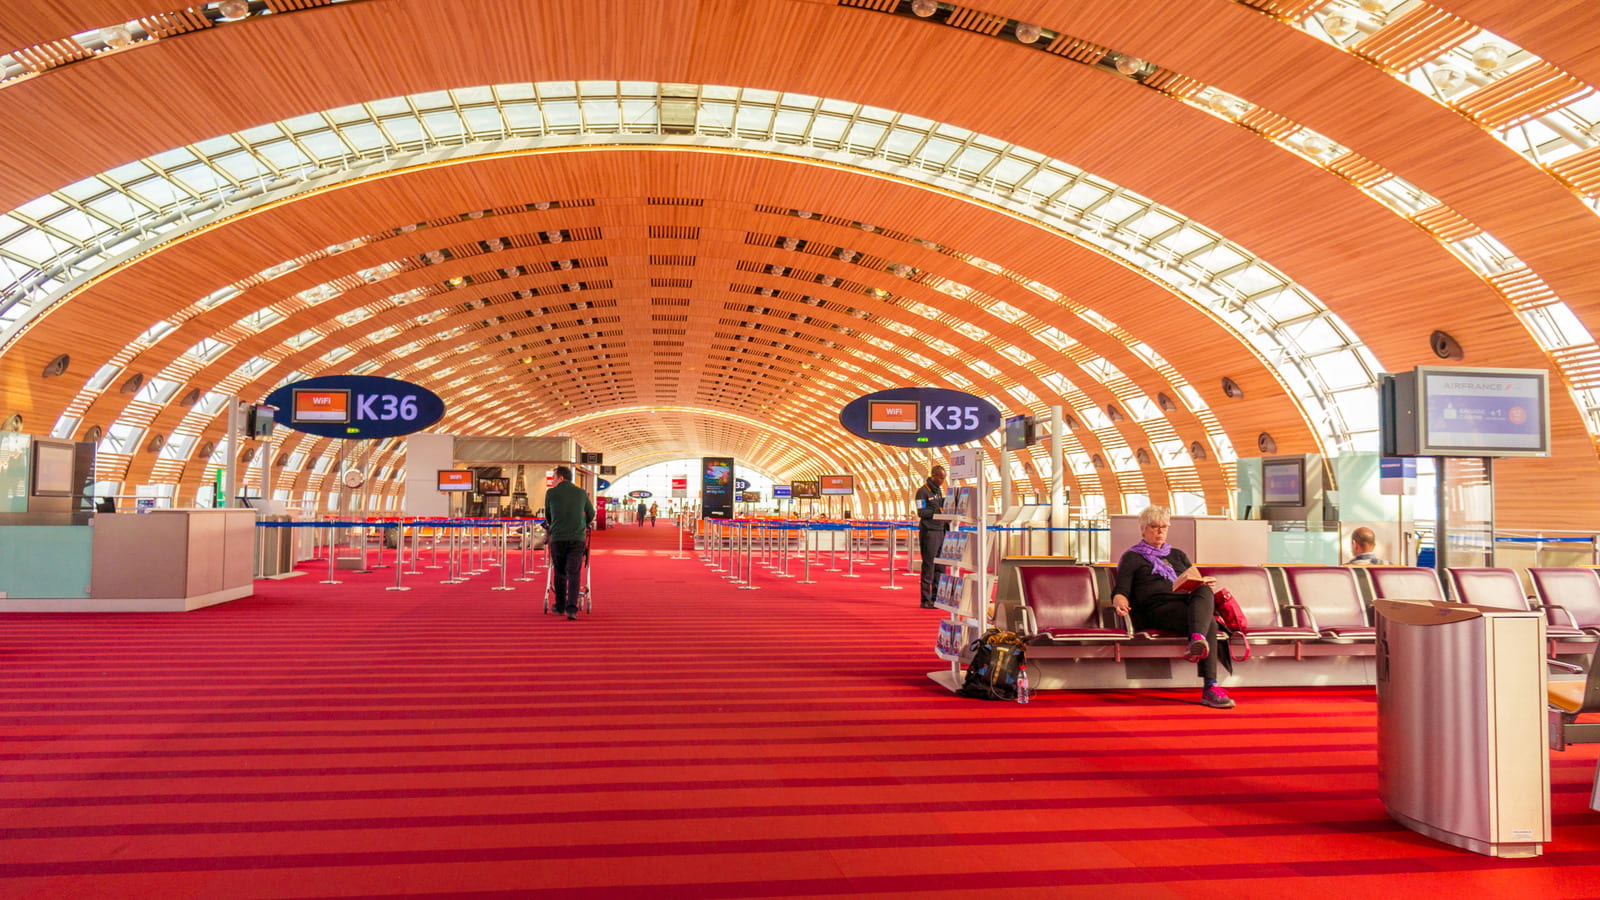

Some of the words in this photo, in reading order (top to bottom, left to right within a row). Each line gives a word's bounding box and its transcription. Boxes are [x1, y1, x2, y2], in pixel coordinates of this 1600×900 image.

[312, 397, 331, 405] WiFi
[356, 394, 418, 420] K36
[925, 405, 979, 430] K35
